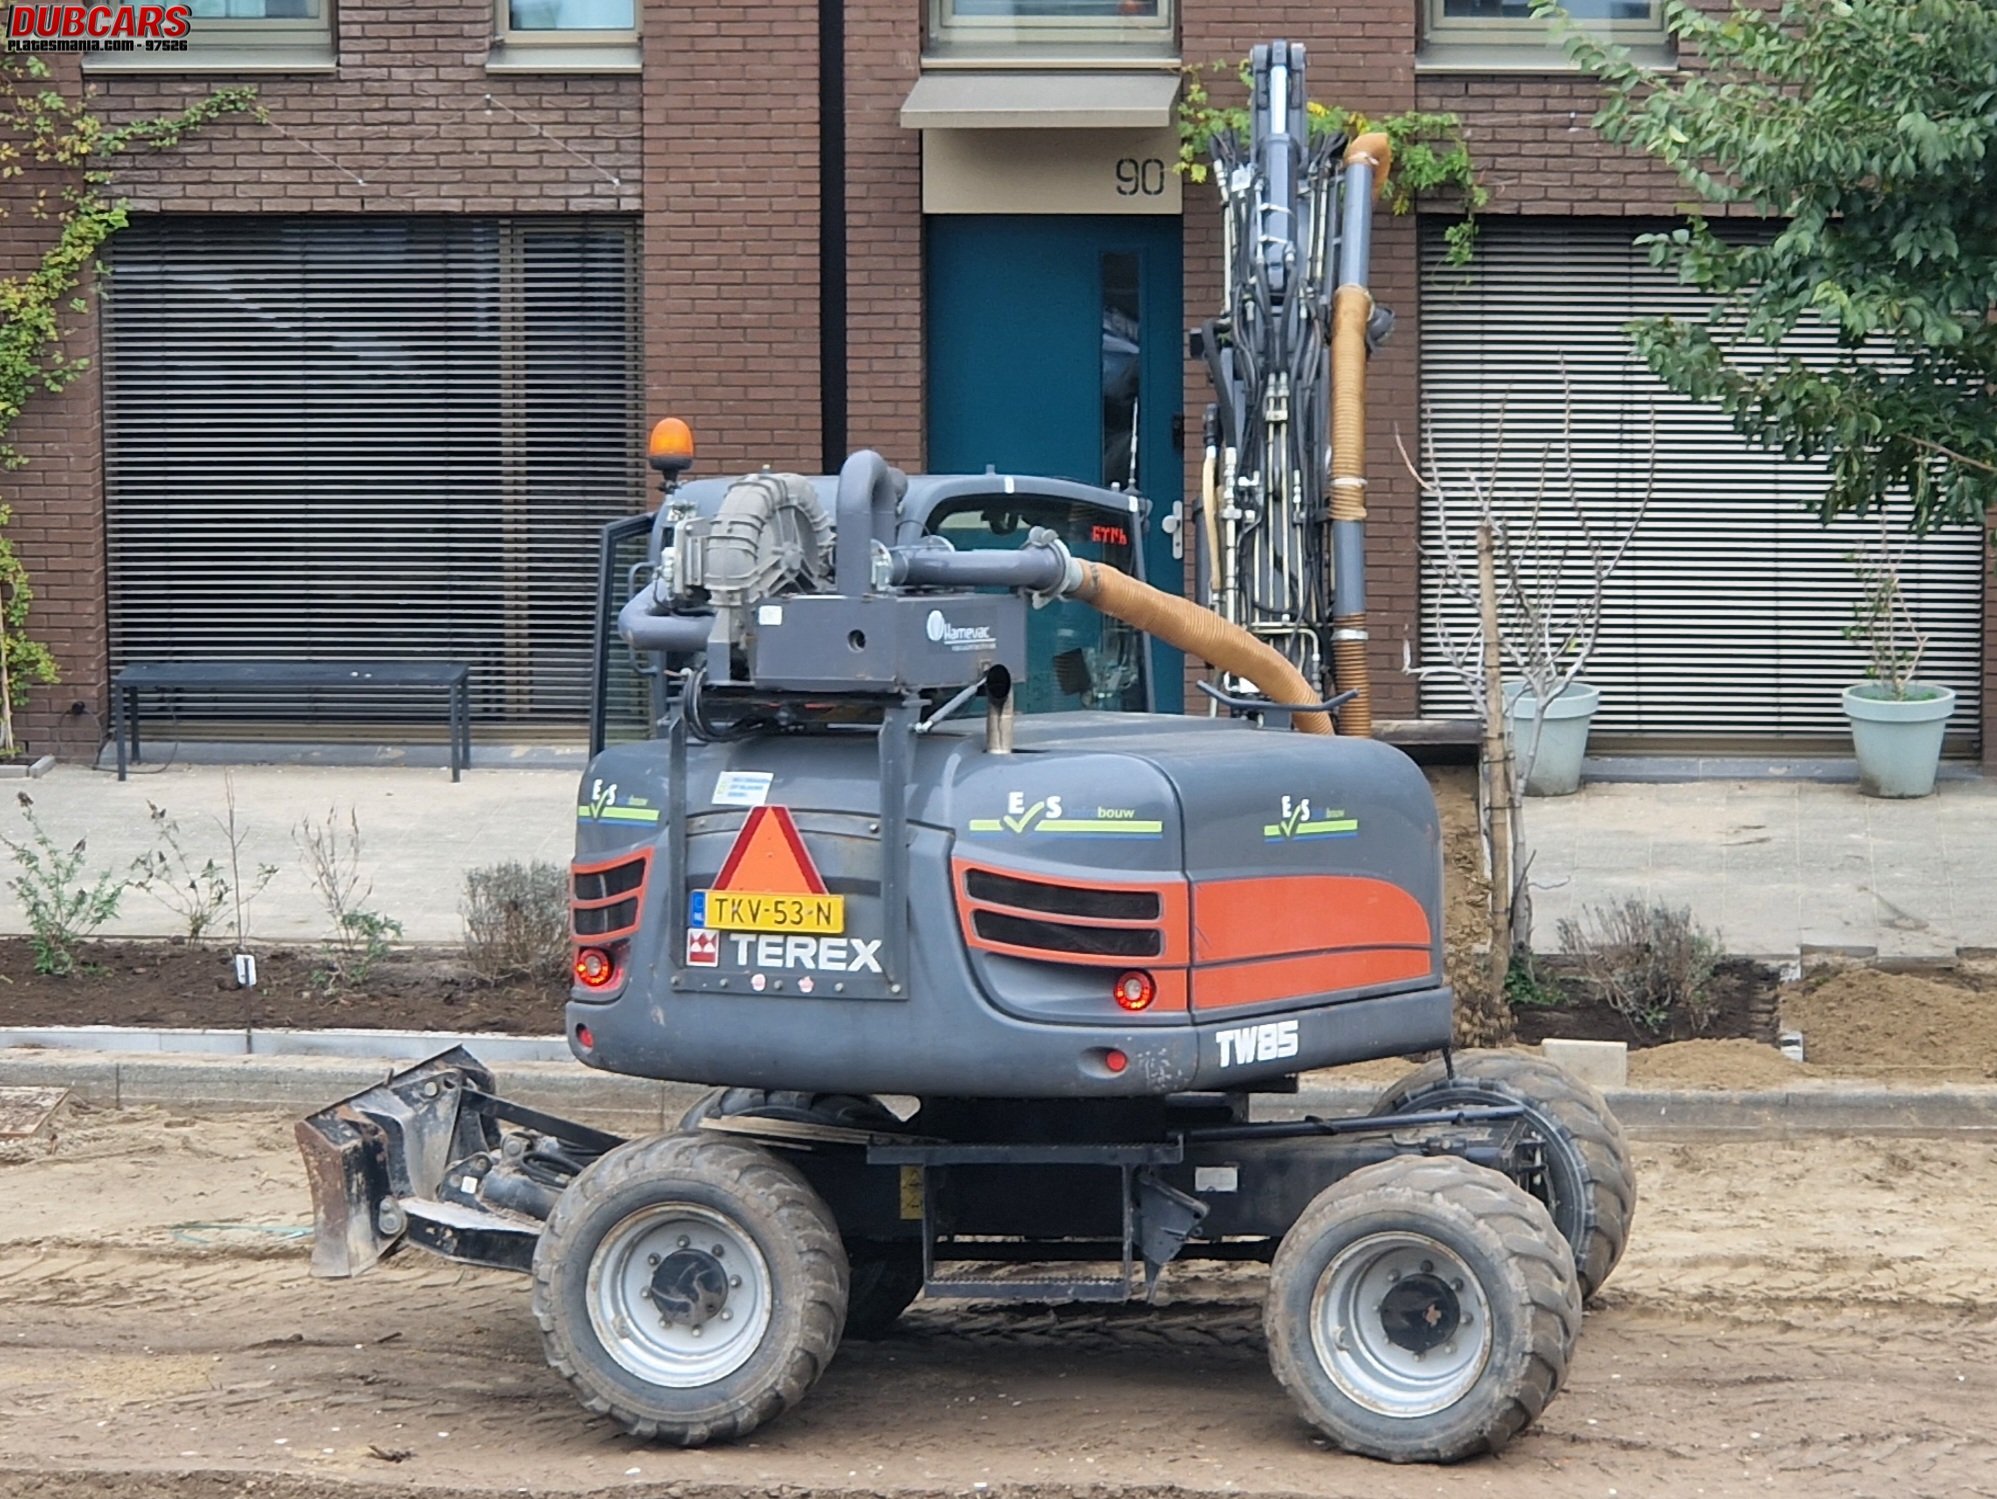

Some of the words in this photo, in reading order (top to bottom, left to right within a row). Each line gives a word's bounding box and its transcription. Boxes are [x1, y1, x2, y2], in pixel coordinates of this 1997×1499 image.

[1116, 159, 1165, 195] 90
[715, 898, 832, 926] TKV-53-N
[729, 933, 883, 973] TEREX
[1216, 1020, 1299, 1068] TW85
